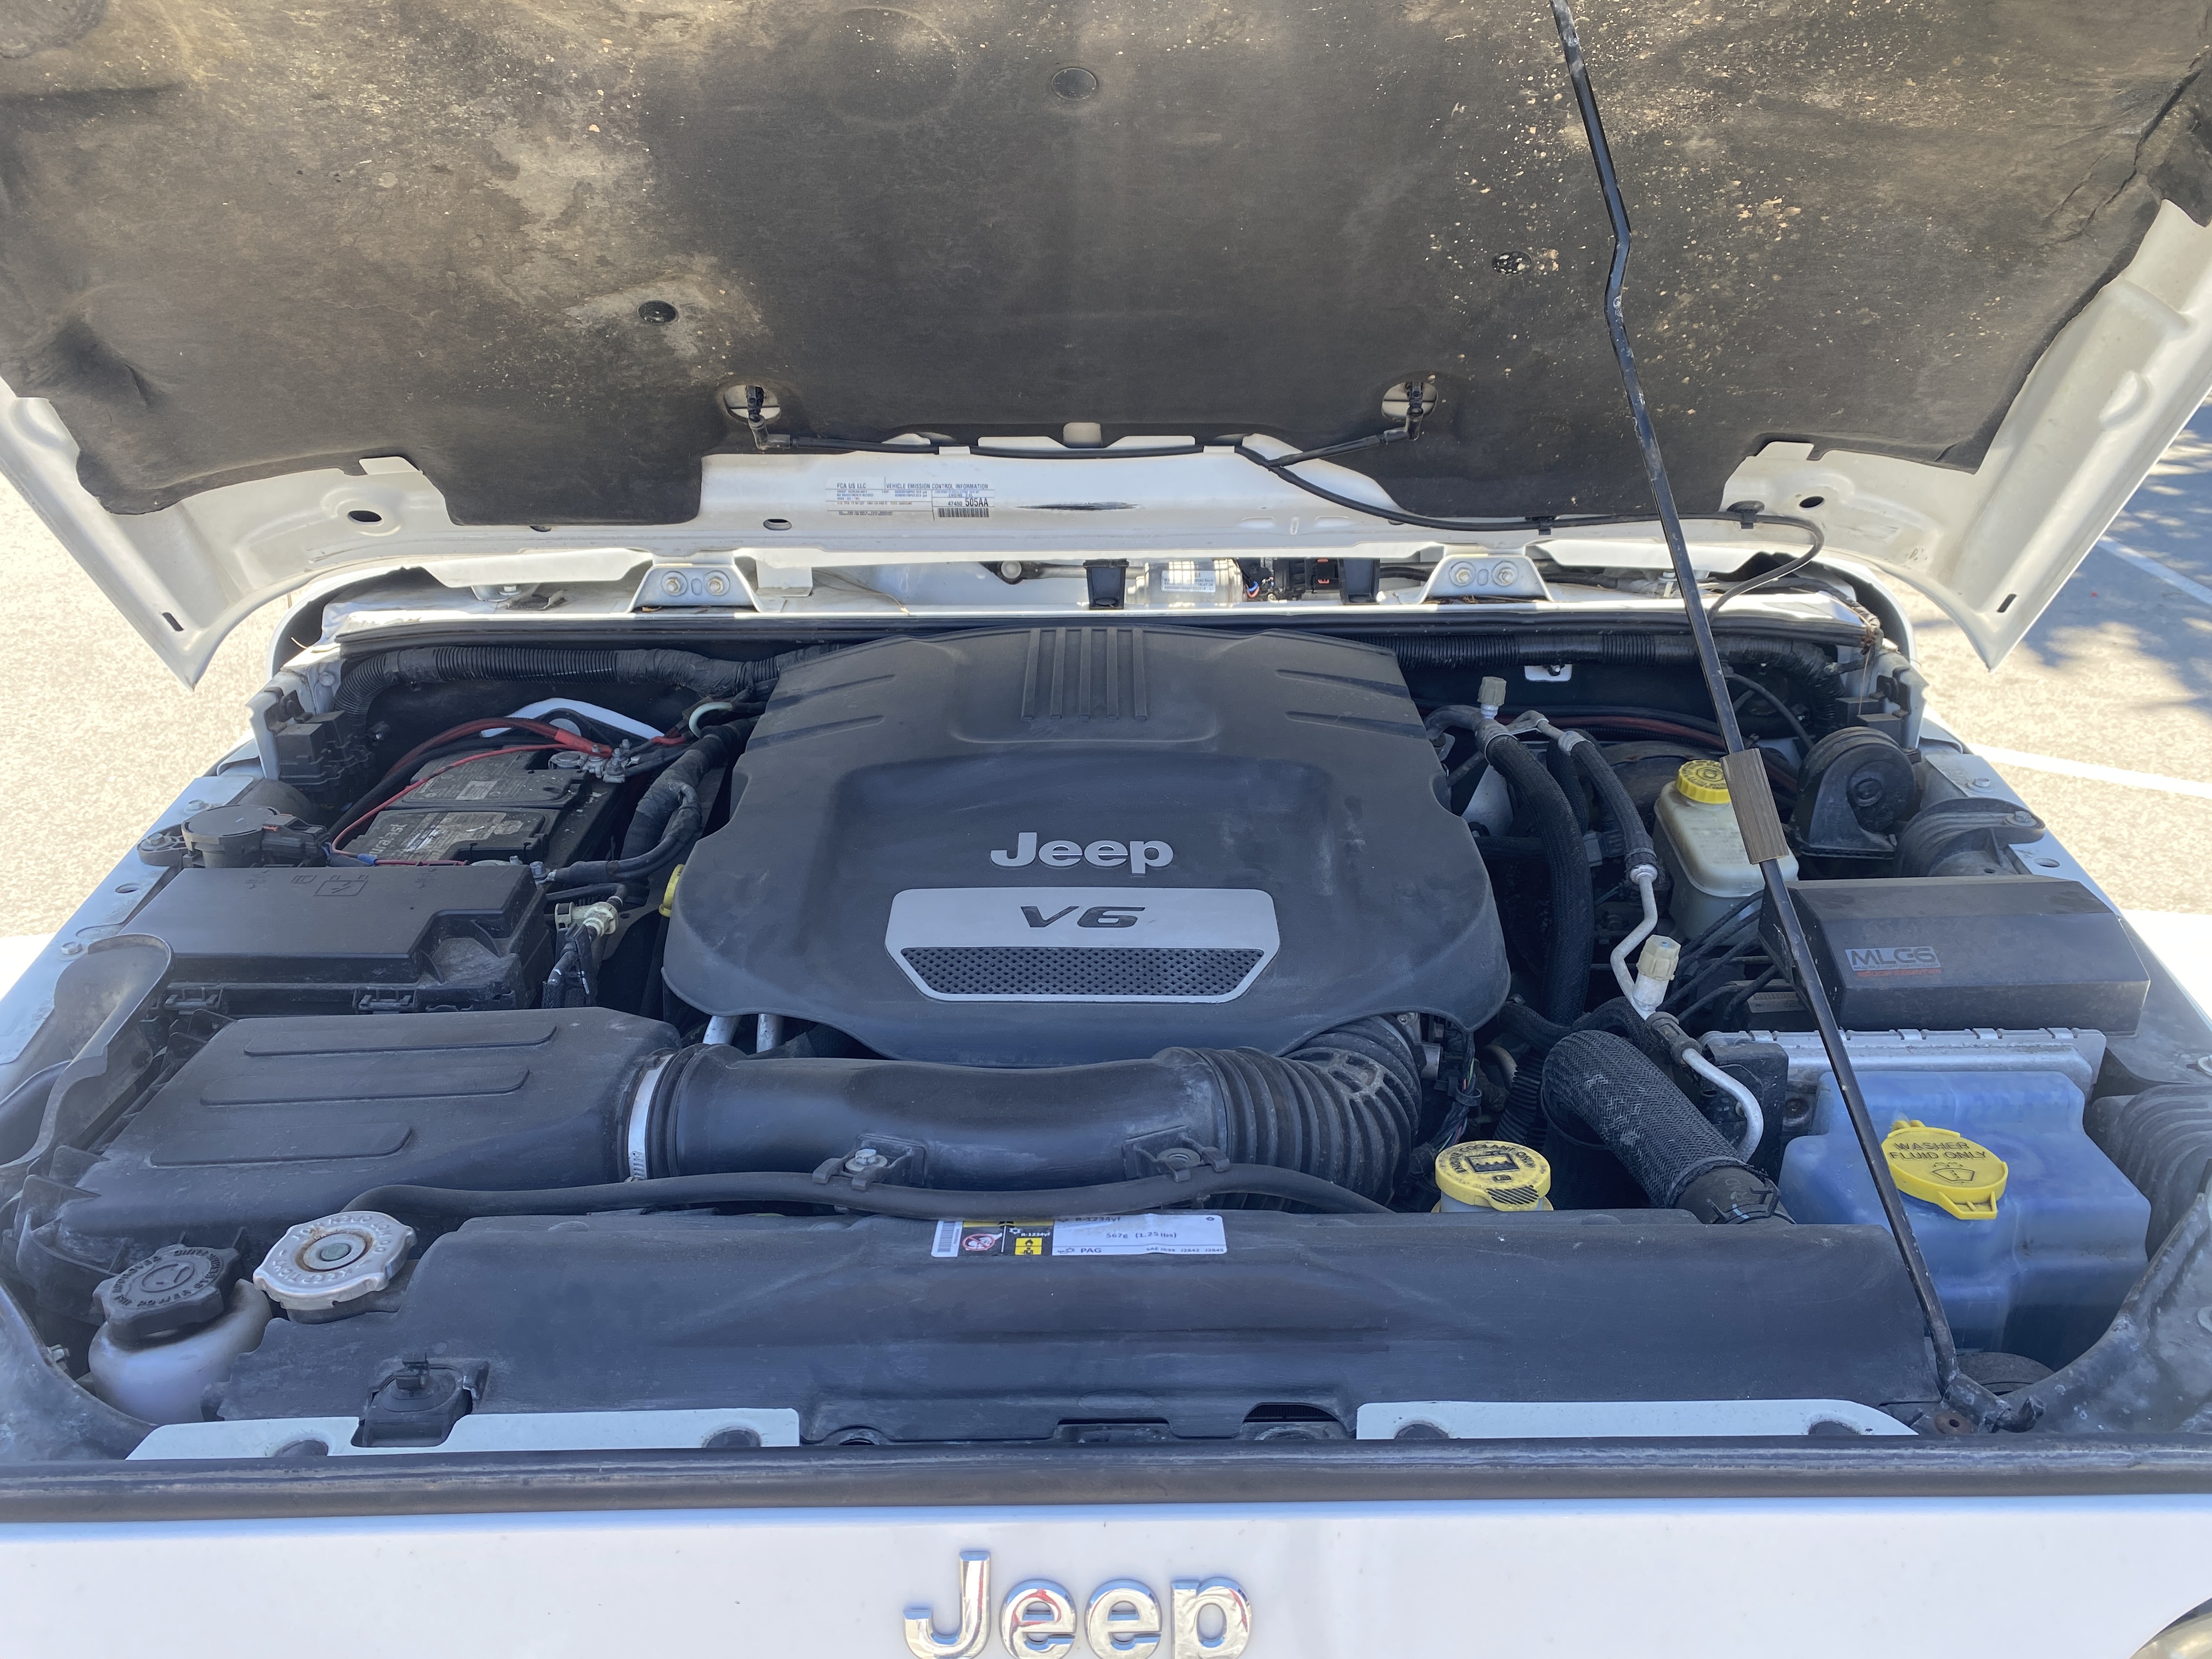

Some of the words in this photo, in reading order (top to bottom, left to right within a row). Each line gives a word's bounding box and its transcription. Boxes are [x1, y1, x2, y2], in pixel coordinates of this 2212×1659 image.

[965, 498, 989, 507] 505AA
[991, 832, 1174, 874] Jeep
[1020, 906, 1146, 928] V6
[1460, 1143, 1516, 1153] COOLANT
[1515, 1151, 1536, 1169] ONLY
[1889, 1152, 1939, 1160] FLUID
[1944, 1151, 1987, 1160] ONLY
[1894, 1142, 1971, 1150] WASHER
[902, 1550, 1253, 1659] Jeep
